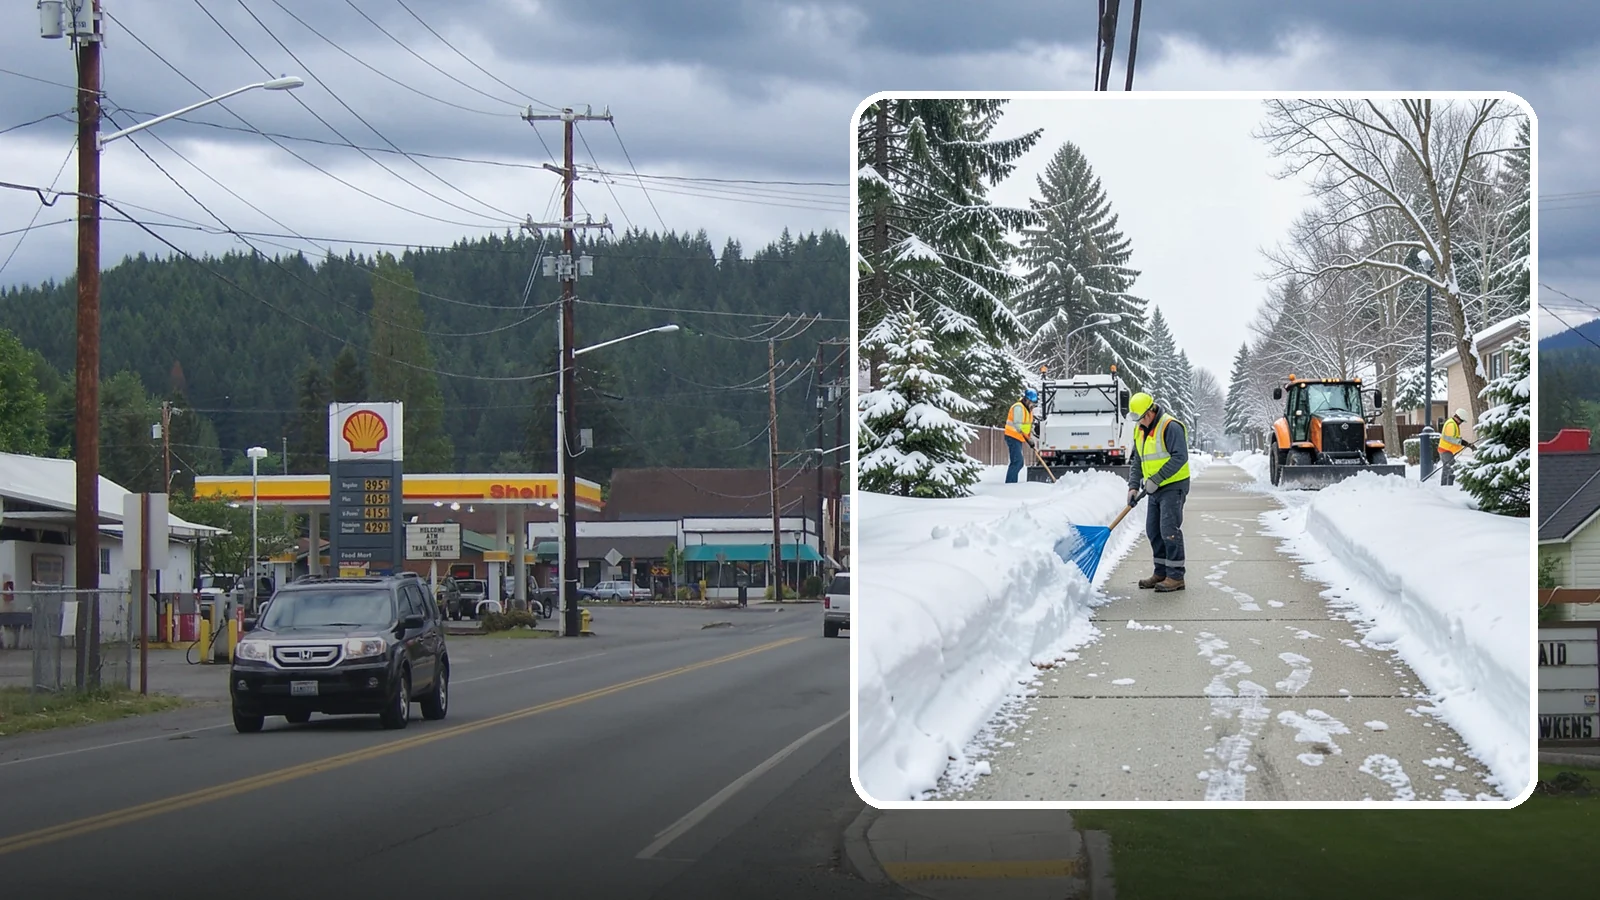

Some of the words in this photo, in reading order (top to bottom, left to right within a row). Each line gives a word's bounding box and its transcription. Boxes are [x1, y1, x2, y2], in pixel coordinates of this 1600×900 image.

[366, 480, 383, 490] 395
[490, 484, 547, 499] Shell
[365, 494, 383, 504] 405
[365, 508, 383, 518] 415
[365, 522, 383, 532] 429
[1538, 642, 1567, 666] AID
